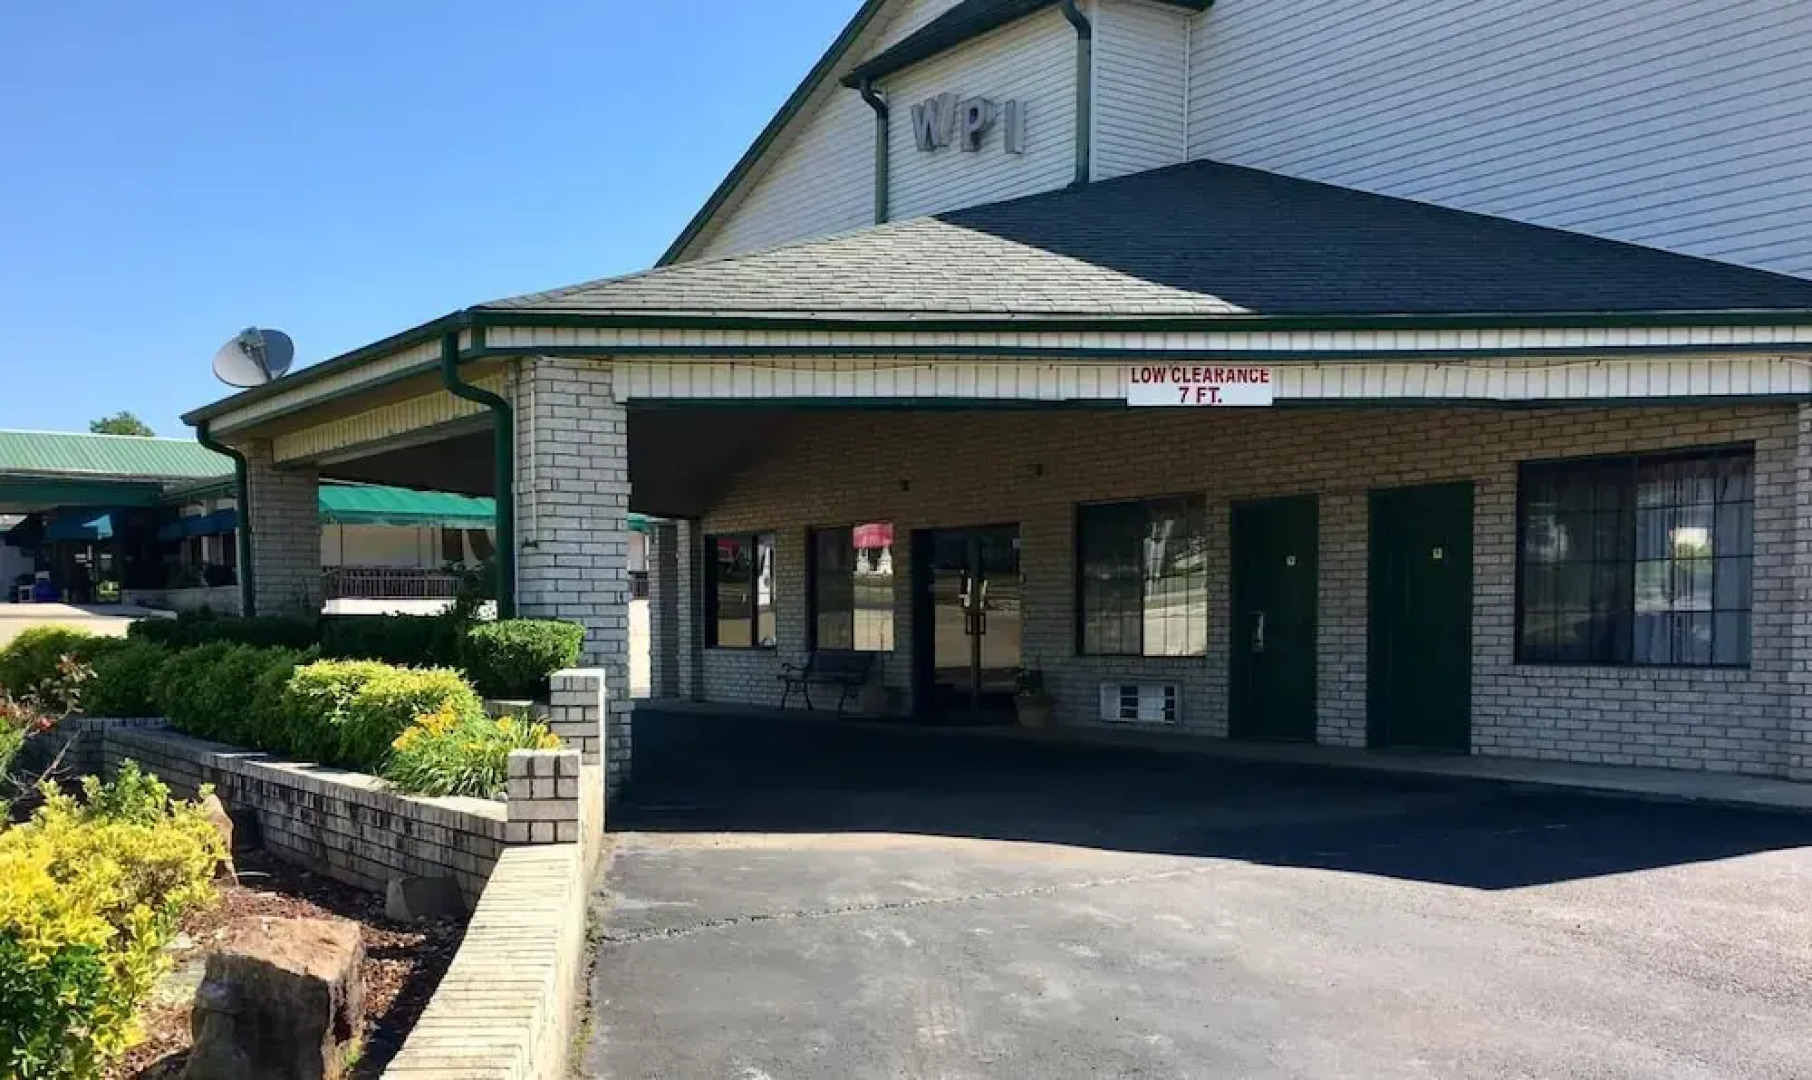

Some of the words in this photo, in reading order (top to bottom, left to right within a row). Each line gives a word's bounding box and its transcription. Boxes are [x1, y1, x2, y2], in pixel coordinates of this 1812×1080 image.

[911, 93, 1026, 154] WPI
[1131, 367, 1166, 383] LOW
[1171, 367, 1269, 383] CLEARANCE
[1179, 387, 1190, 403] 7
[1196, 387, 1223, 403] FT.
